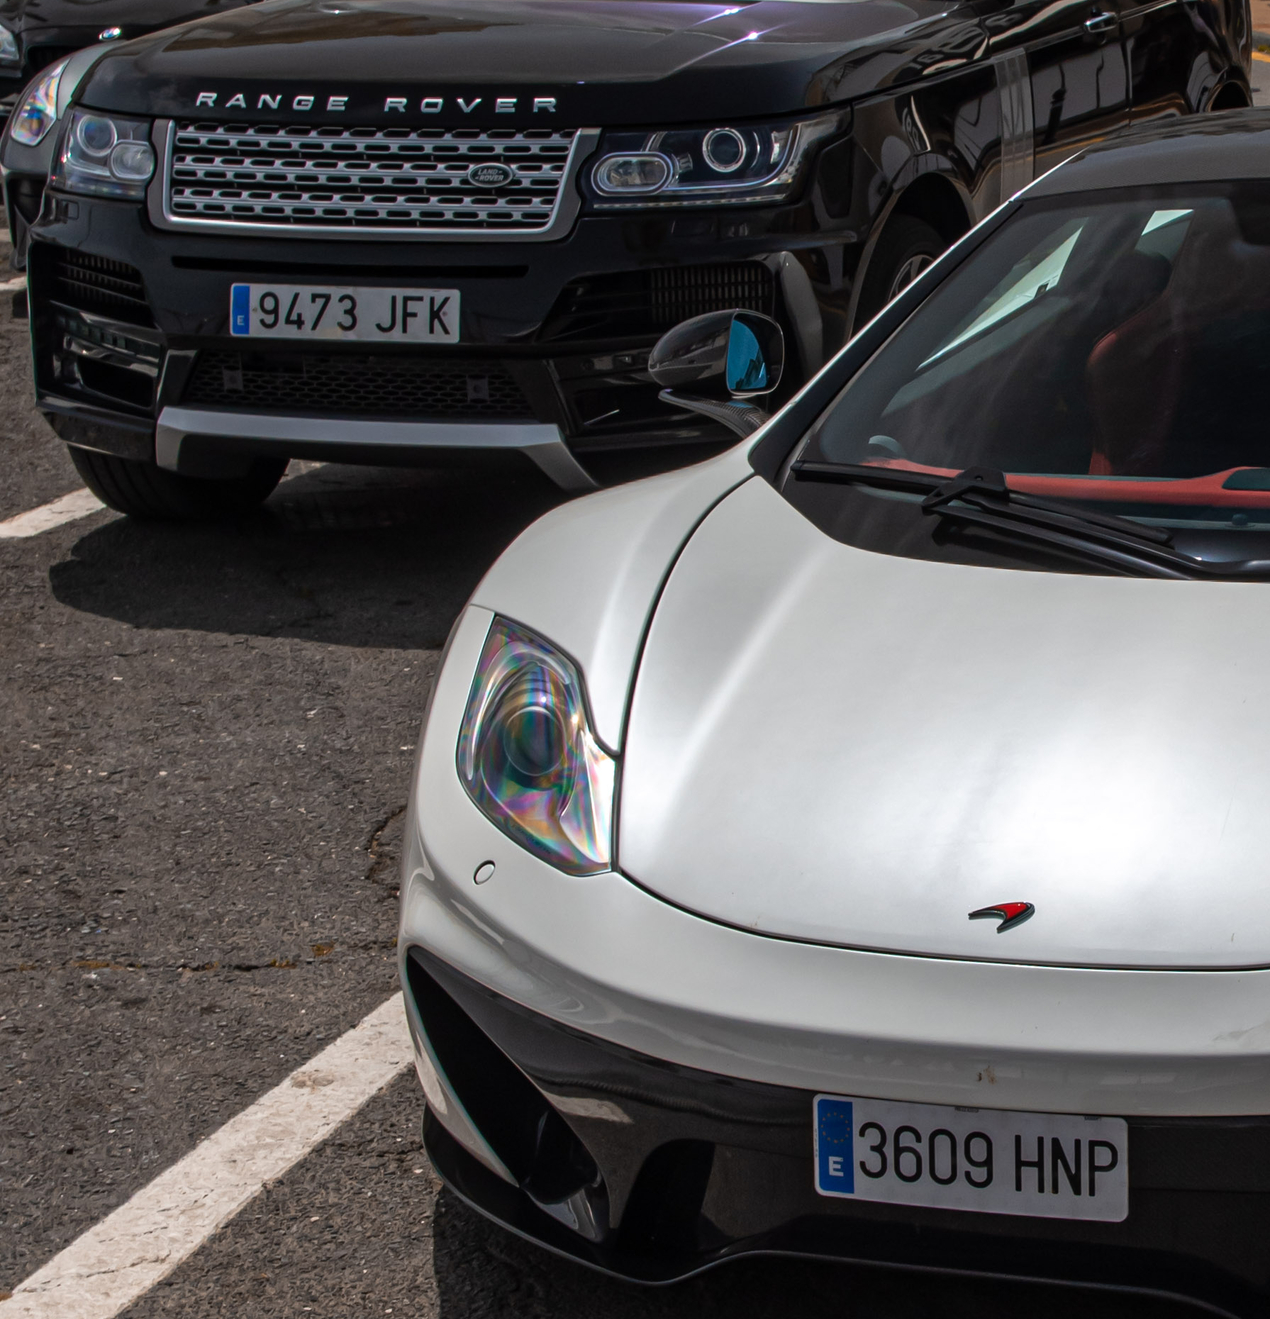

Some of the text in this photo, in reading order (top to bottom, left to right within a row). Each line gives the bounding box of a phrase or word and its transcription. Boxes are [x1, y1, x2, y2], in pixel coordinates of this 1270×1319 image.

[196, 92, 557, 114] RANGE ROVER
[236, 291, 451, 335] E 9473 JFK
[828, 1121, 1119, 1197] E 3609 HNP
